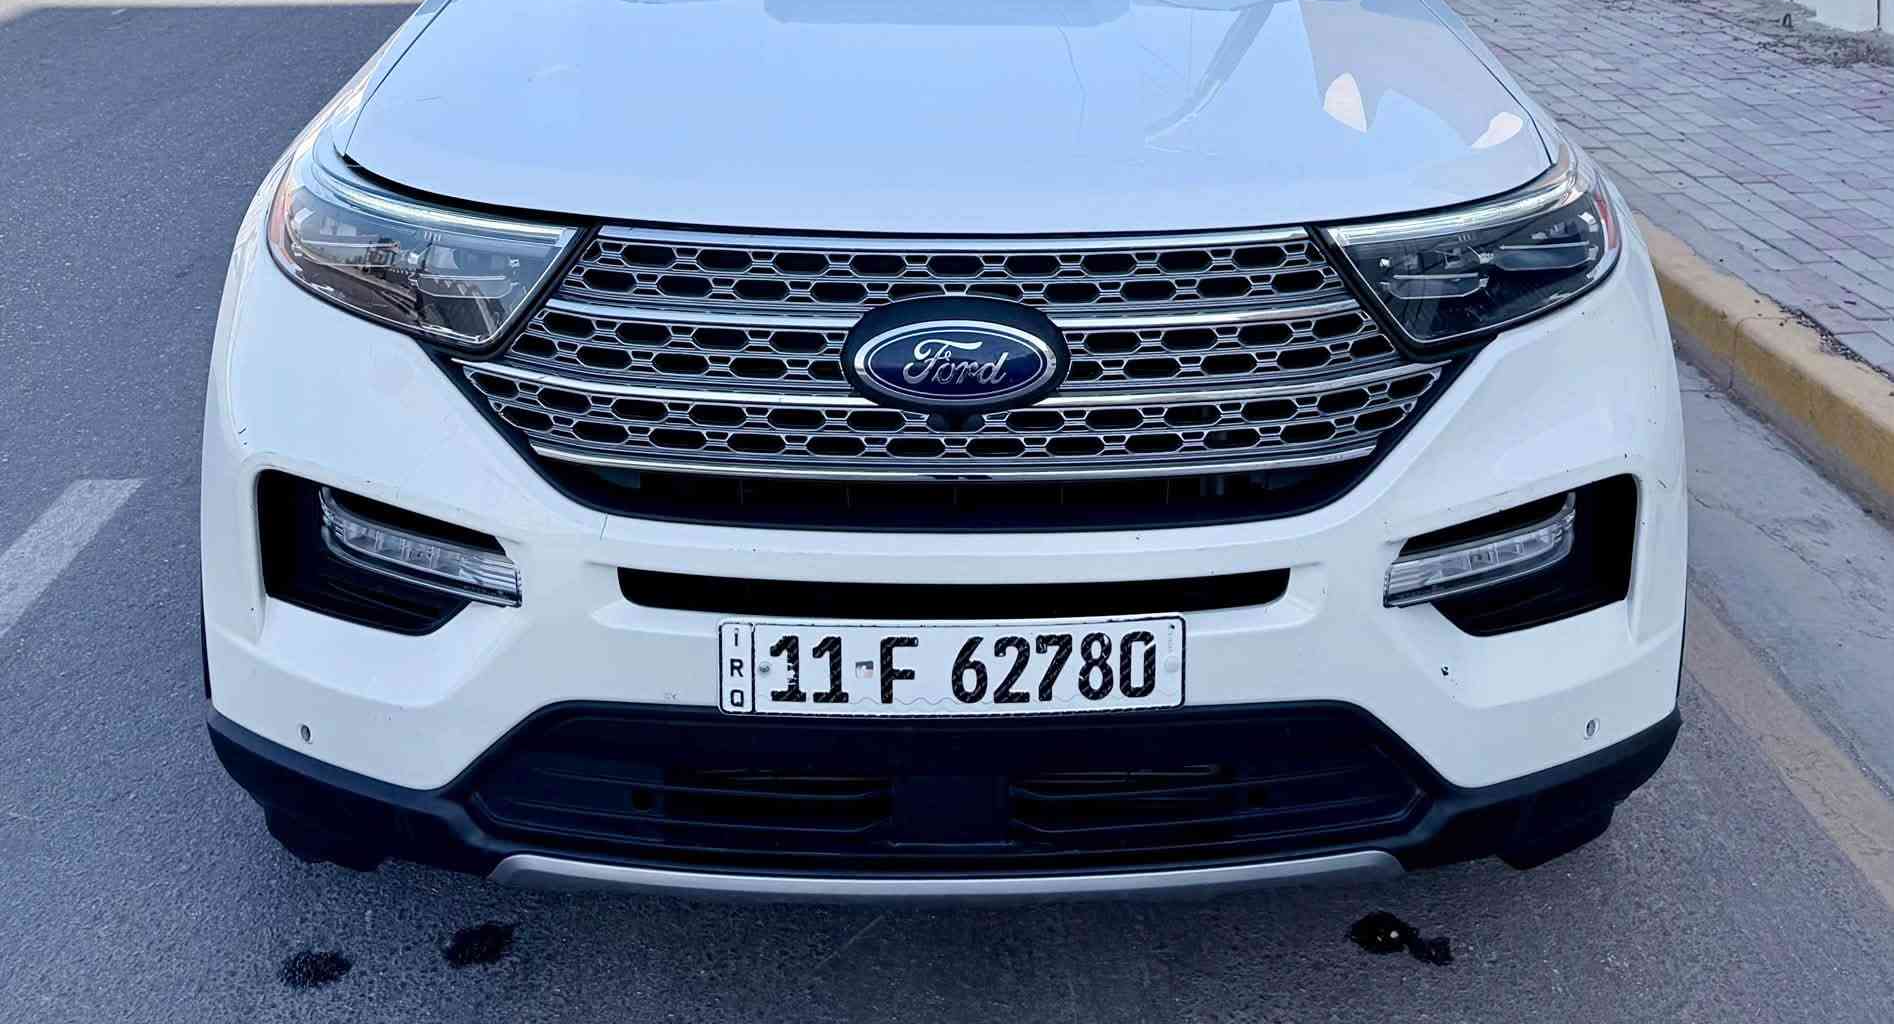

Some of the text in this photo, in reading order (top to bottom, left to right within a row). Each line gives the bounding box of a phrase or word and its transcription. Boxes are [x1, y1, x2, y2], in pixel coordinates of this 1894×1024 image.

[902, 338, 1010, 385] Ford
[729, 629, 745, 708] IRQ
[769, 630, 1157, 704] 11 F 62780
